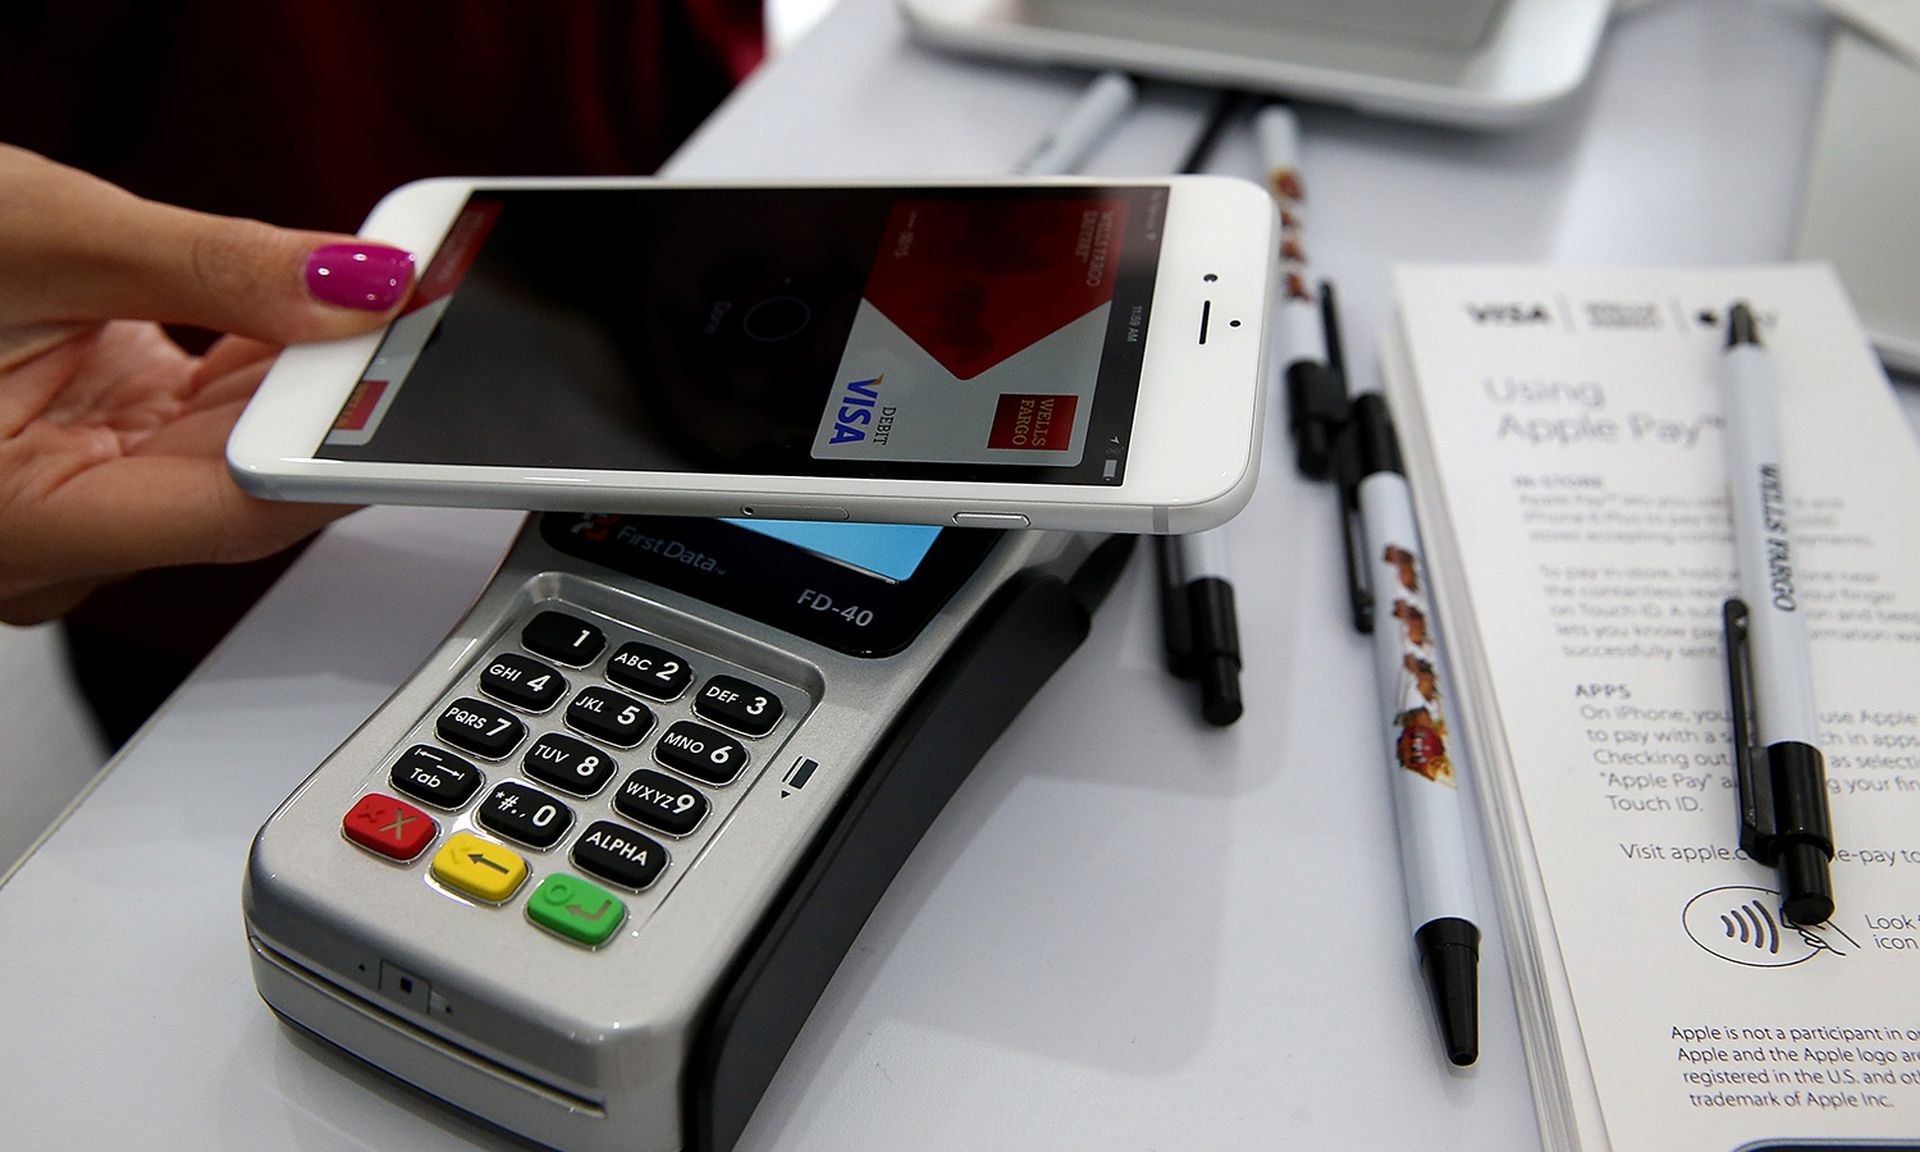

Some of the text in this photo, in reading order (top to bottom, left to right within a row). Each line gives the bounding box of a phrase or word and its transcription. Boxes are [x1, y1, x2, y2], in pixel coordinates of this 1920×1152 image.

[1126, 305, 1143, 343] 11:59 AM
[1467, 301, 1550, 326] VISA
[1481, 376, 1606, 409] Using
[830, 373, 884, 445] VISA
[873, 406, 897, 446] DEBIT
[1012, 398, 1035, 446] FARGO
[1031, 397, 1055, 447] WELLS
[1497, 412, 1619, 447] Apple
[1759, 463, 1787, 533] WELLS
[1767, 537, 1797, 612] FARGO
[797, 588, 875, 628] FD-40
[573, 629, 590, 648] 1
[1594, 626, 1631, 642] you
[1634, 622, 1686, 638] know
[1563, 644, 1674, 662] successfully
[489, 663, 550, 692] GHI 4
[614, 650, 680, 682] ABC 2
[706, 685, 767, 717] DEF 3
[1575, 683, 1631, 698] APPS
[444, 707, 512, 737] PQRS 7
[575, 695, 639, 726] JKL 5
[1580, 703, 1611, 721] On
[1819, 709, 1919, 727] use Apple
[665, 731, 731, 765] MNO 6
[1587, 728, 1609, 743] to
[1613, 730, 1649, 746] pay
[1654, 729, 1700, 743] with
[1848, 733, 1868, 746] in
[534, 743, 600, 777] TUV 8
[1593, 748, 1689, 770] Checking
[1830, 756, 1852, 769] as
[409, 767, 441, 789] Tab
[1843, 778, 1891, 795] your
[624, 779, 696, 816] WXYZ 9
[1605, 794, 1704, 813] Touch ID.
[532, 804, 557, 828] 0
[586, 831, 650, 868] ALPHA
[1620, 842, 1666, 861] Visit
[1864, 913, 1915, 931] Look
[1873, 933, 1919, 951] icon
[1671, 1025, 1722, 1043] Apple
[1724, 1026, 1739, 1040] is
[1742, 1026, 1773, 1041] not
[1775, 1028, 1787, 1041] a
[1790, 1025, 1885, 1044] participant
[1886, 1027, 1904, 1041] in
[1677, 1046, 1730, 1066] Apple
[1733, 1047, 1767, 1063] and
[1769, 1047, 1800, 1063] the
[1804, 1046, 1855, 1066] Apple
[1857, 1047, 1898, 1067] logo
[1682, 1068, 1770, 1088] registered
[1773, 1069, 1792, 1084] in
[1794, 1069, 1825, 1084] the
[1828, 1069, 1861, 1085] U.S.
[1863, 1069, 1897, 1085] and
[1690, 1090, 1895, 1111] trademark of Apple Inc.
